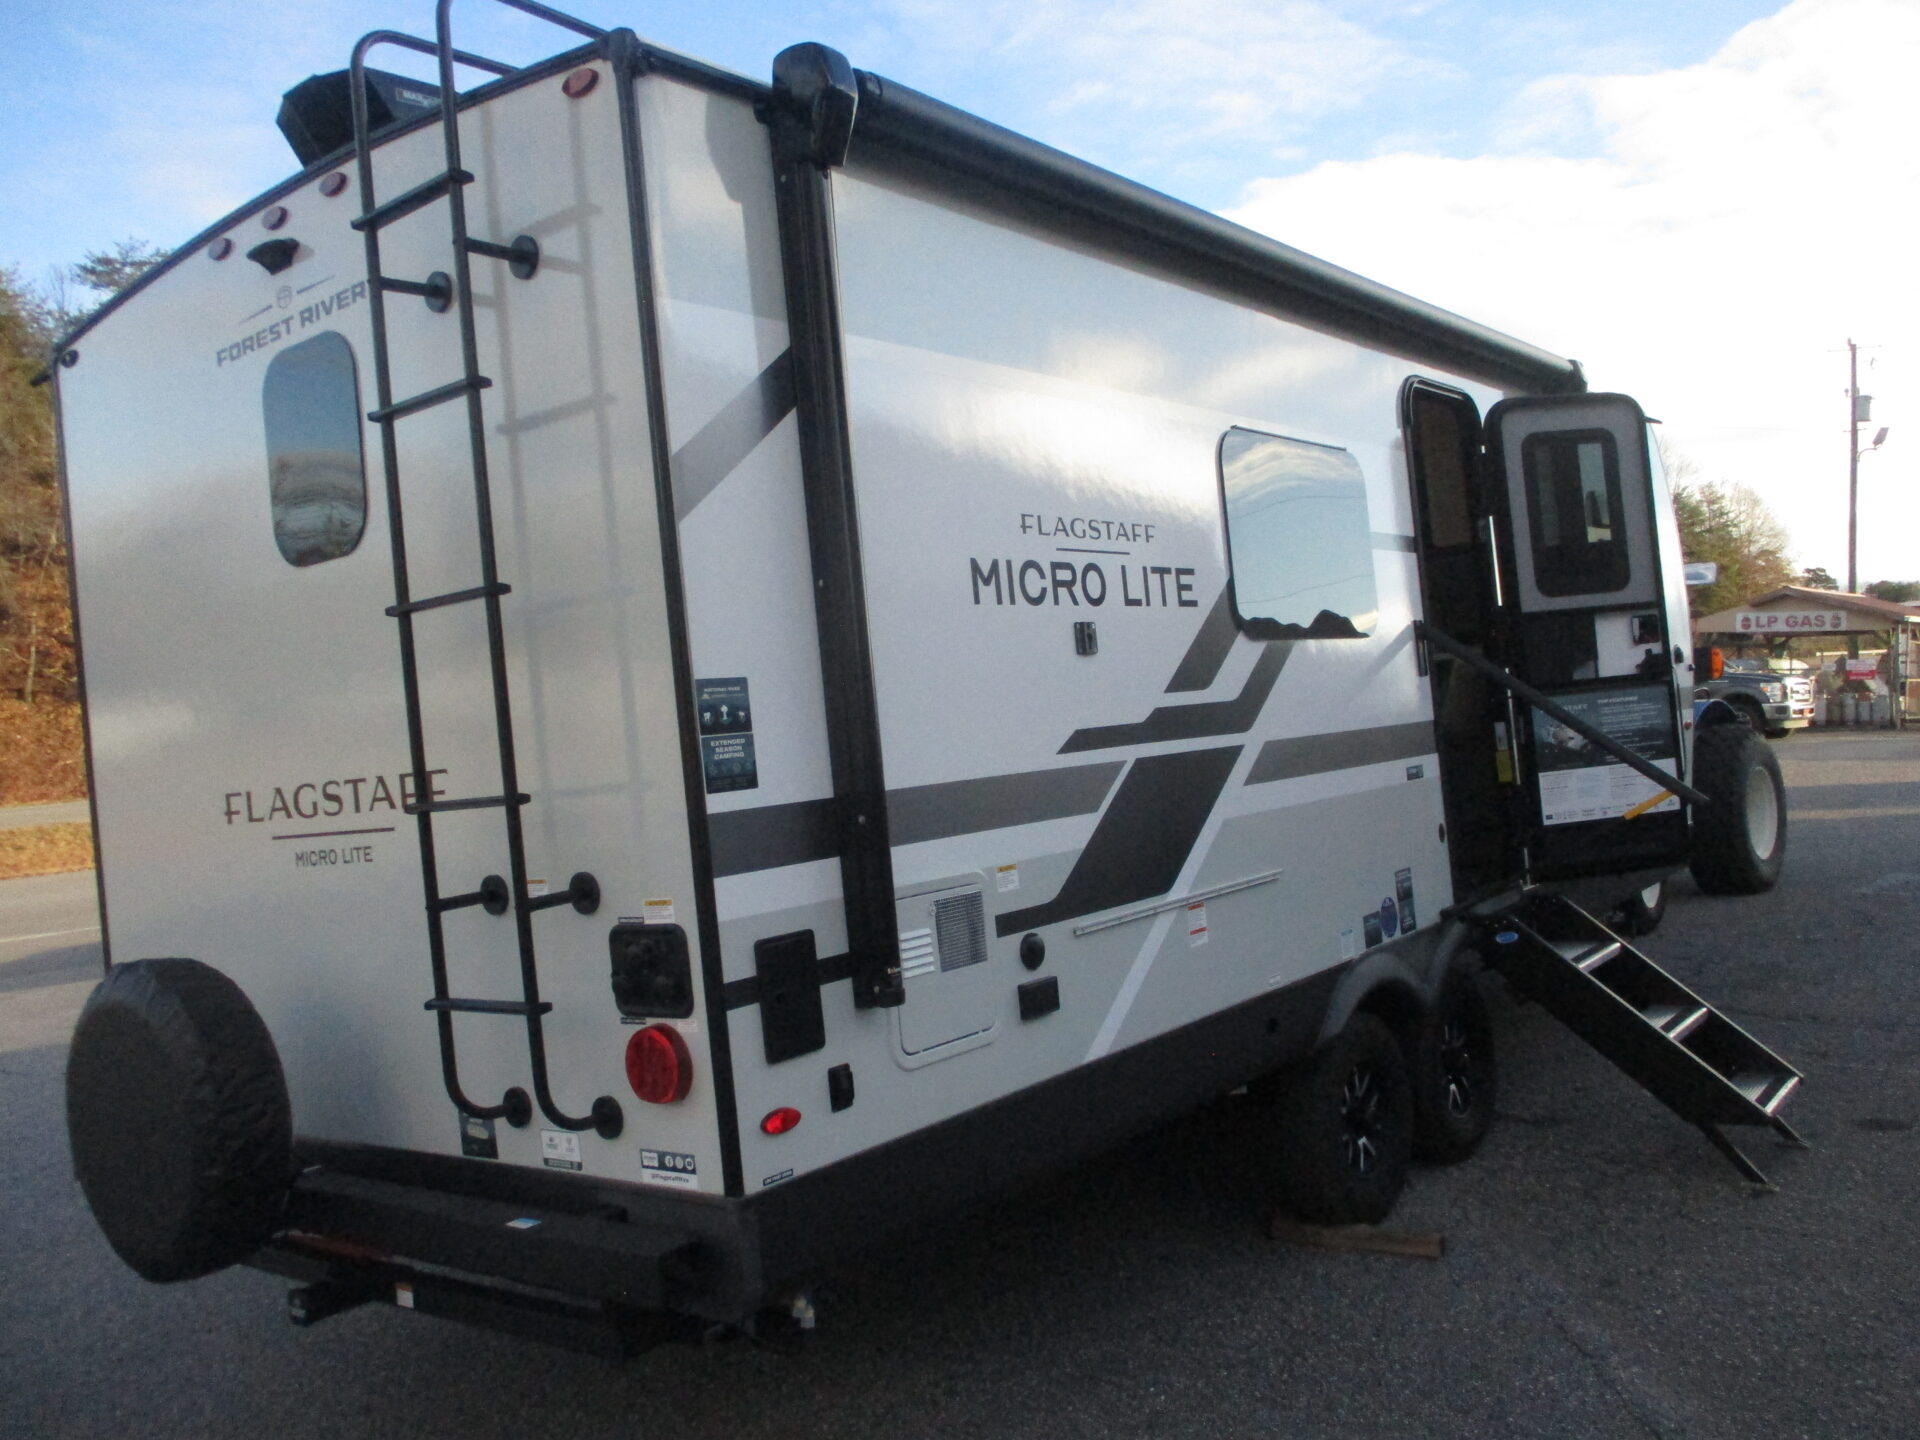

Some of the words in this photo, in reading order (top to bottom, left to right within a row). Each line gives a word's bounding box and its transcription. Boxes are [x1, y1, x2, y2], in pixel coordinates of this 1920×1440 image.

[216, 315, 295, 367] FOREST
[299, 279, 367, 329] RIVER
[1020, 513, 1156, 543] FLAGSTAFF
[970, 557, 1107, 607] MICRO
[1121, 564, 1199, 607] LITE
[1755, 615, 1779, 628] LP
[1784, 614, 1827, 628] GAS
[710, 738, 746, 747] EXTENDED
[295, 849, 337, 867] MICRO
[342, 846, 374, 864] LITE
